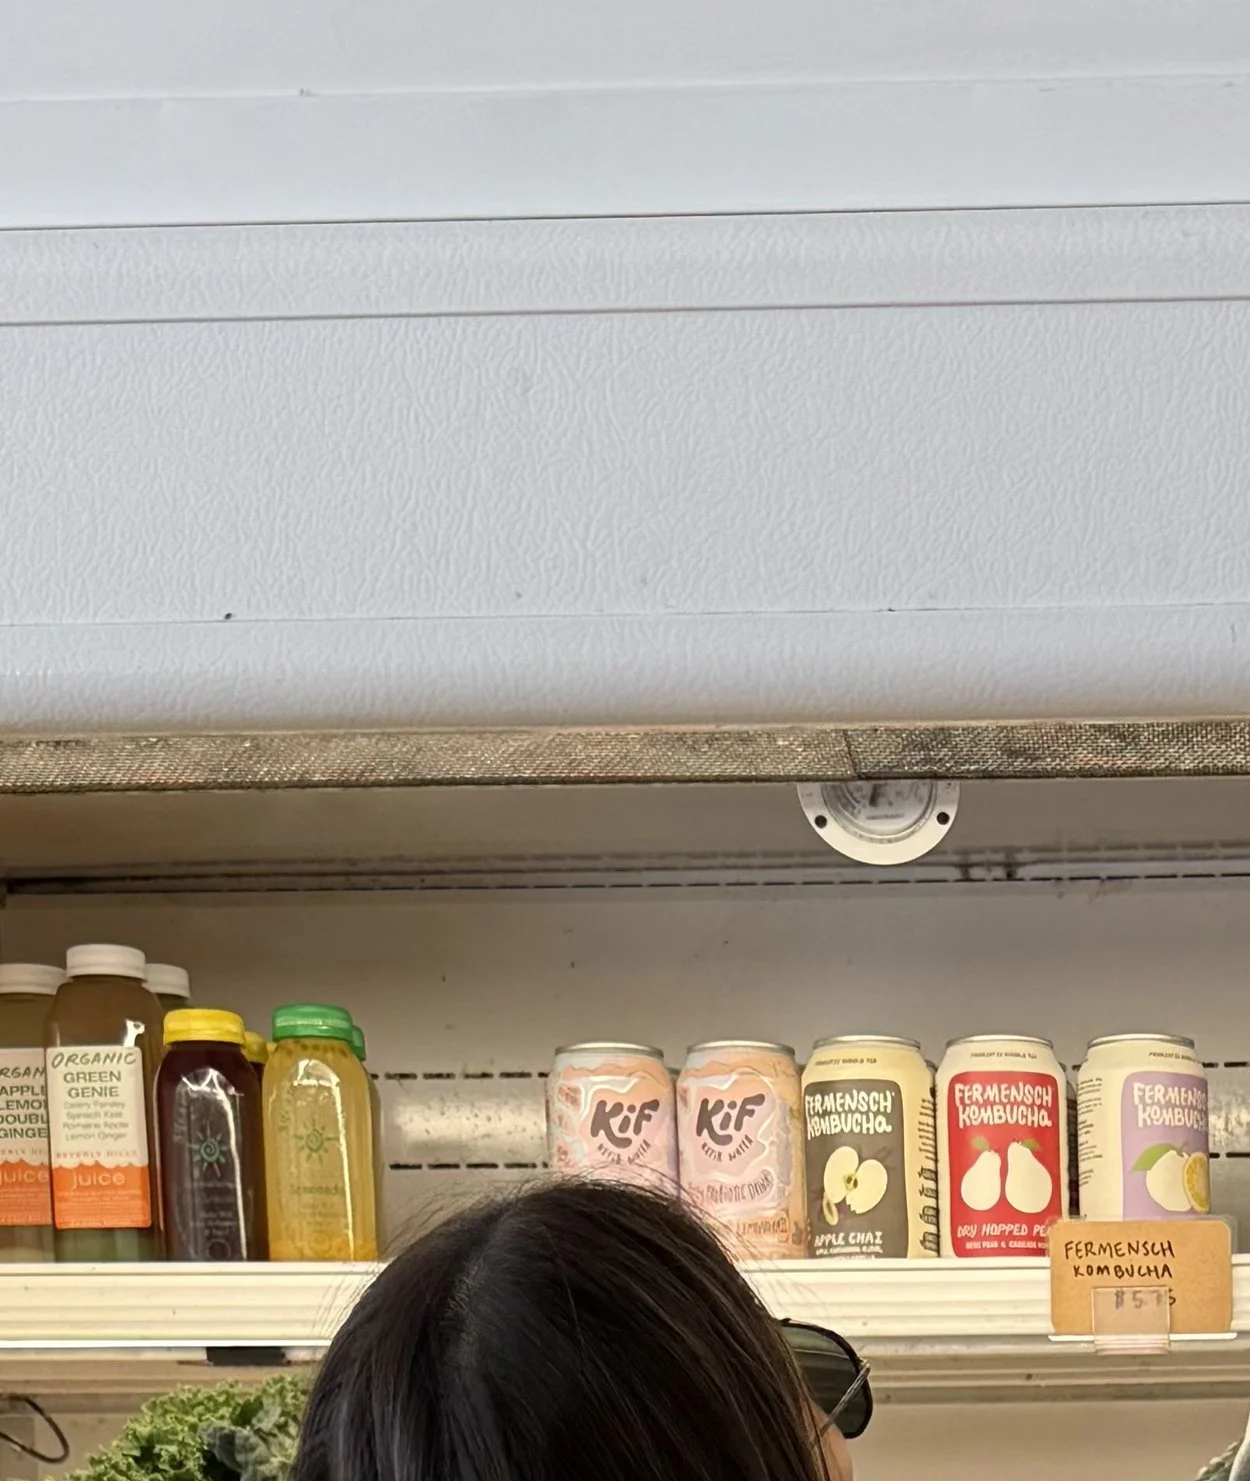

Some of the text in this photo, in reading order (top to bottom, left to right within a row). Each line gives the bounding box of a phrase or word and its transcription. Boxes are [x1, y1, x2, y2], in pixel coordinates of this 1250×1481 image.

[51, 1052, 137, 1069] ORGANIC
[0, 1067, 46, 1078] RGAN
[63, 1070, 122, 1084] GREEN
[68, 1086, 120, 1099] GENIE
[954, 1081, 1052, 1107] FERMENSCH
[805, 1089, 892, 1116] FERMENSCH
[0, 1114, 49, 1125] DOUBL
[0, 1128, 48, 1139] GINGE
[71, 1171, 126, 1190] juice
[957, 1223, 1047, 1238] DRY HOPPED PE
[814, 1231, 883, 1247] APPLE CHAI
[1065, 1240, 1175, 1260] FERMENSCH
[1073, 1264, 1173, 1279] KOMBUCHA
